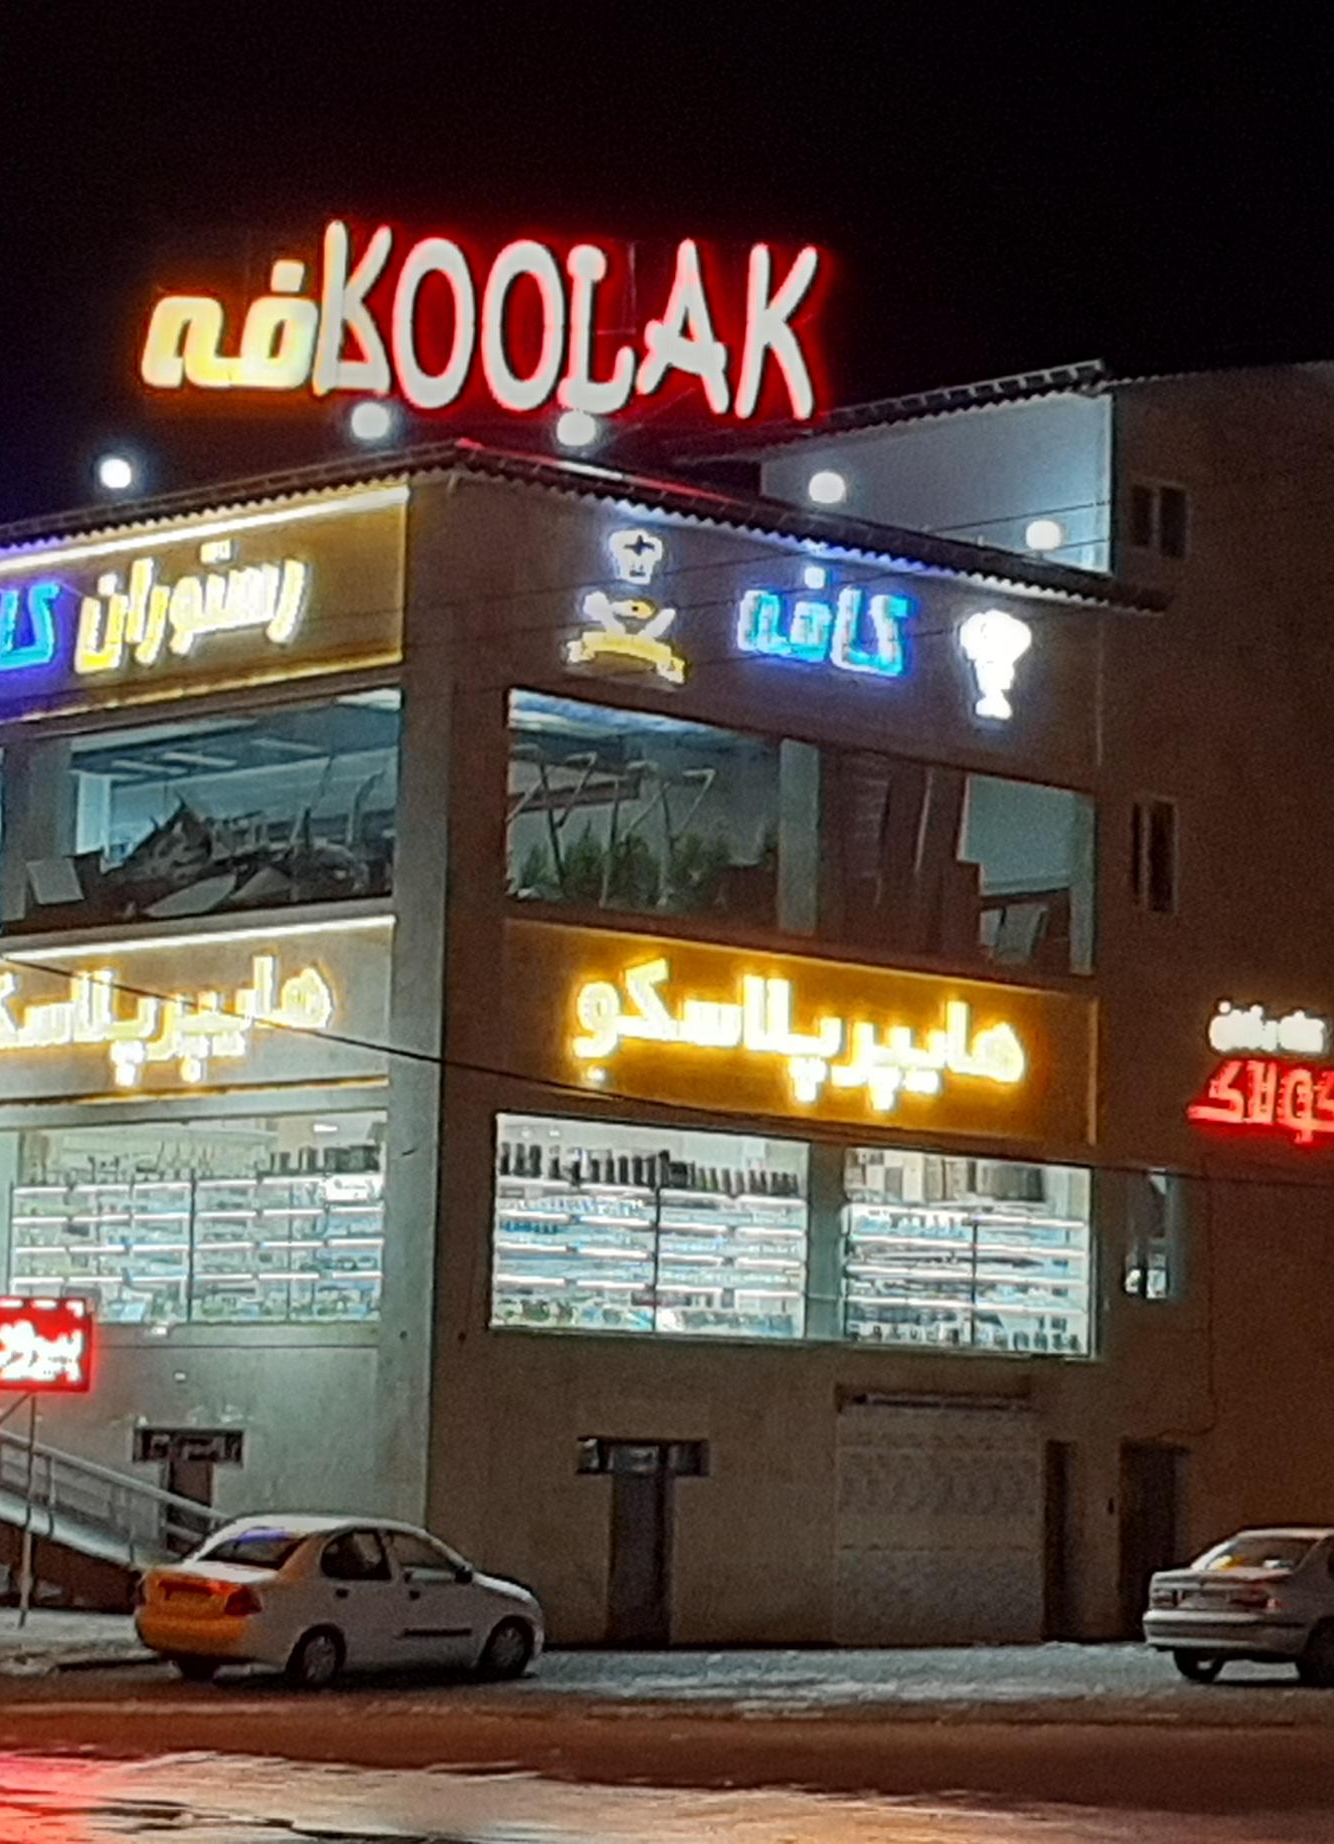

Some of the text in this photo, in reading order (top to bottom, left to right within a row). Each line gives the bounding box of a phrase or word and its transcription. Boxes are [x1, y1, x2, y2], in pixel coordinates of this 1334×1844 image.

[312, 219, 818, 421] KOOLAK
[74, 539, 307, 675] رستوران
[737, 566, 912, 677] کافه
